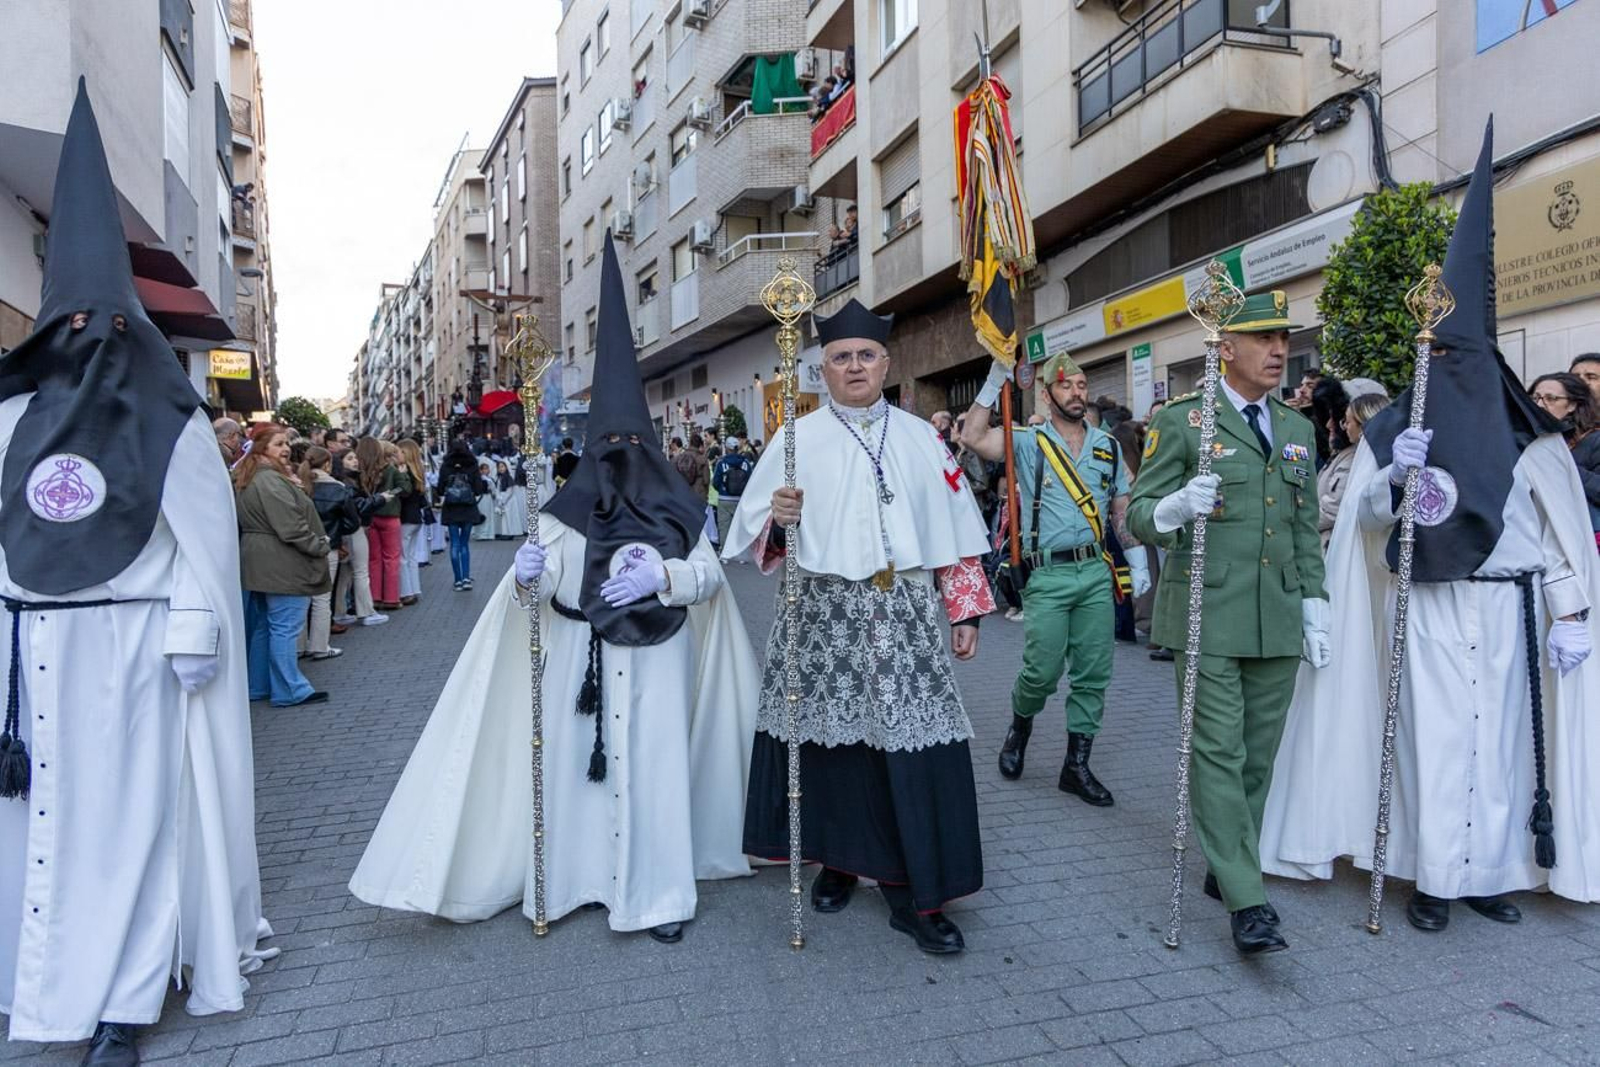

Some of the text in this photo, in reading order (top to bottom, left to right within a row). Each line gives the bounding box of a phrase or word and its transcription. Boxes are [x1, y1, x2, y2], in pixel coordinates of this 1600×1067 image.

[1247, 234, 1326, 268] Servicio Andaluz de Empleo
[1536, 242, 1579, 263] COLEGIO
[1534, 257, 1583, 280] TECNICOS
[1502, 291, 1514, 304] DE
[1517, 288, 1529, 300] LA
[1532, 274, 1587, 296] PROVINCIA
